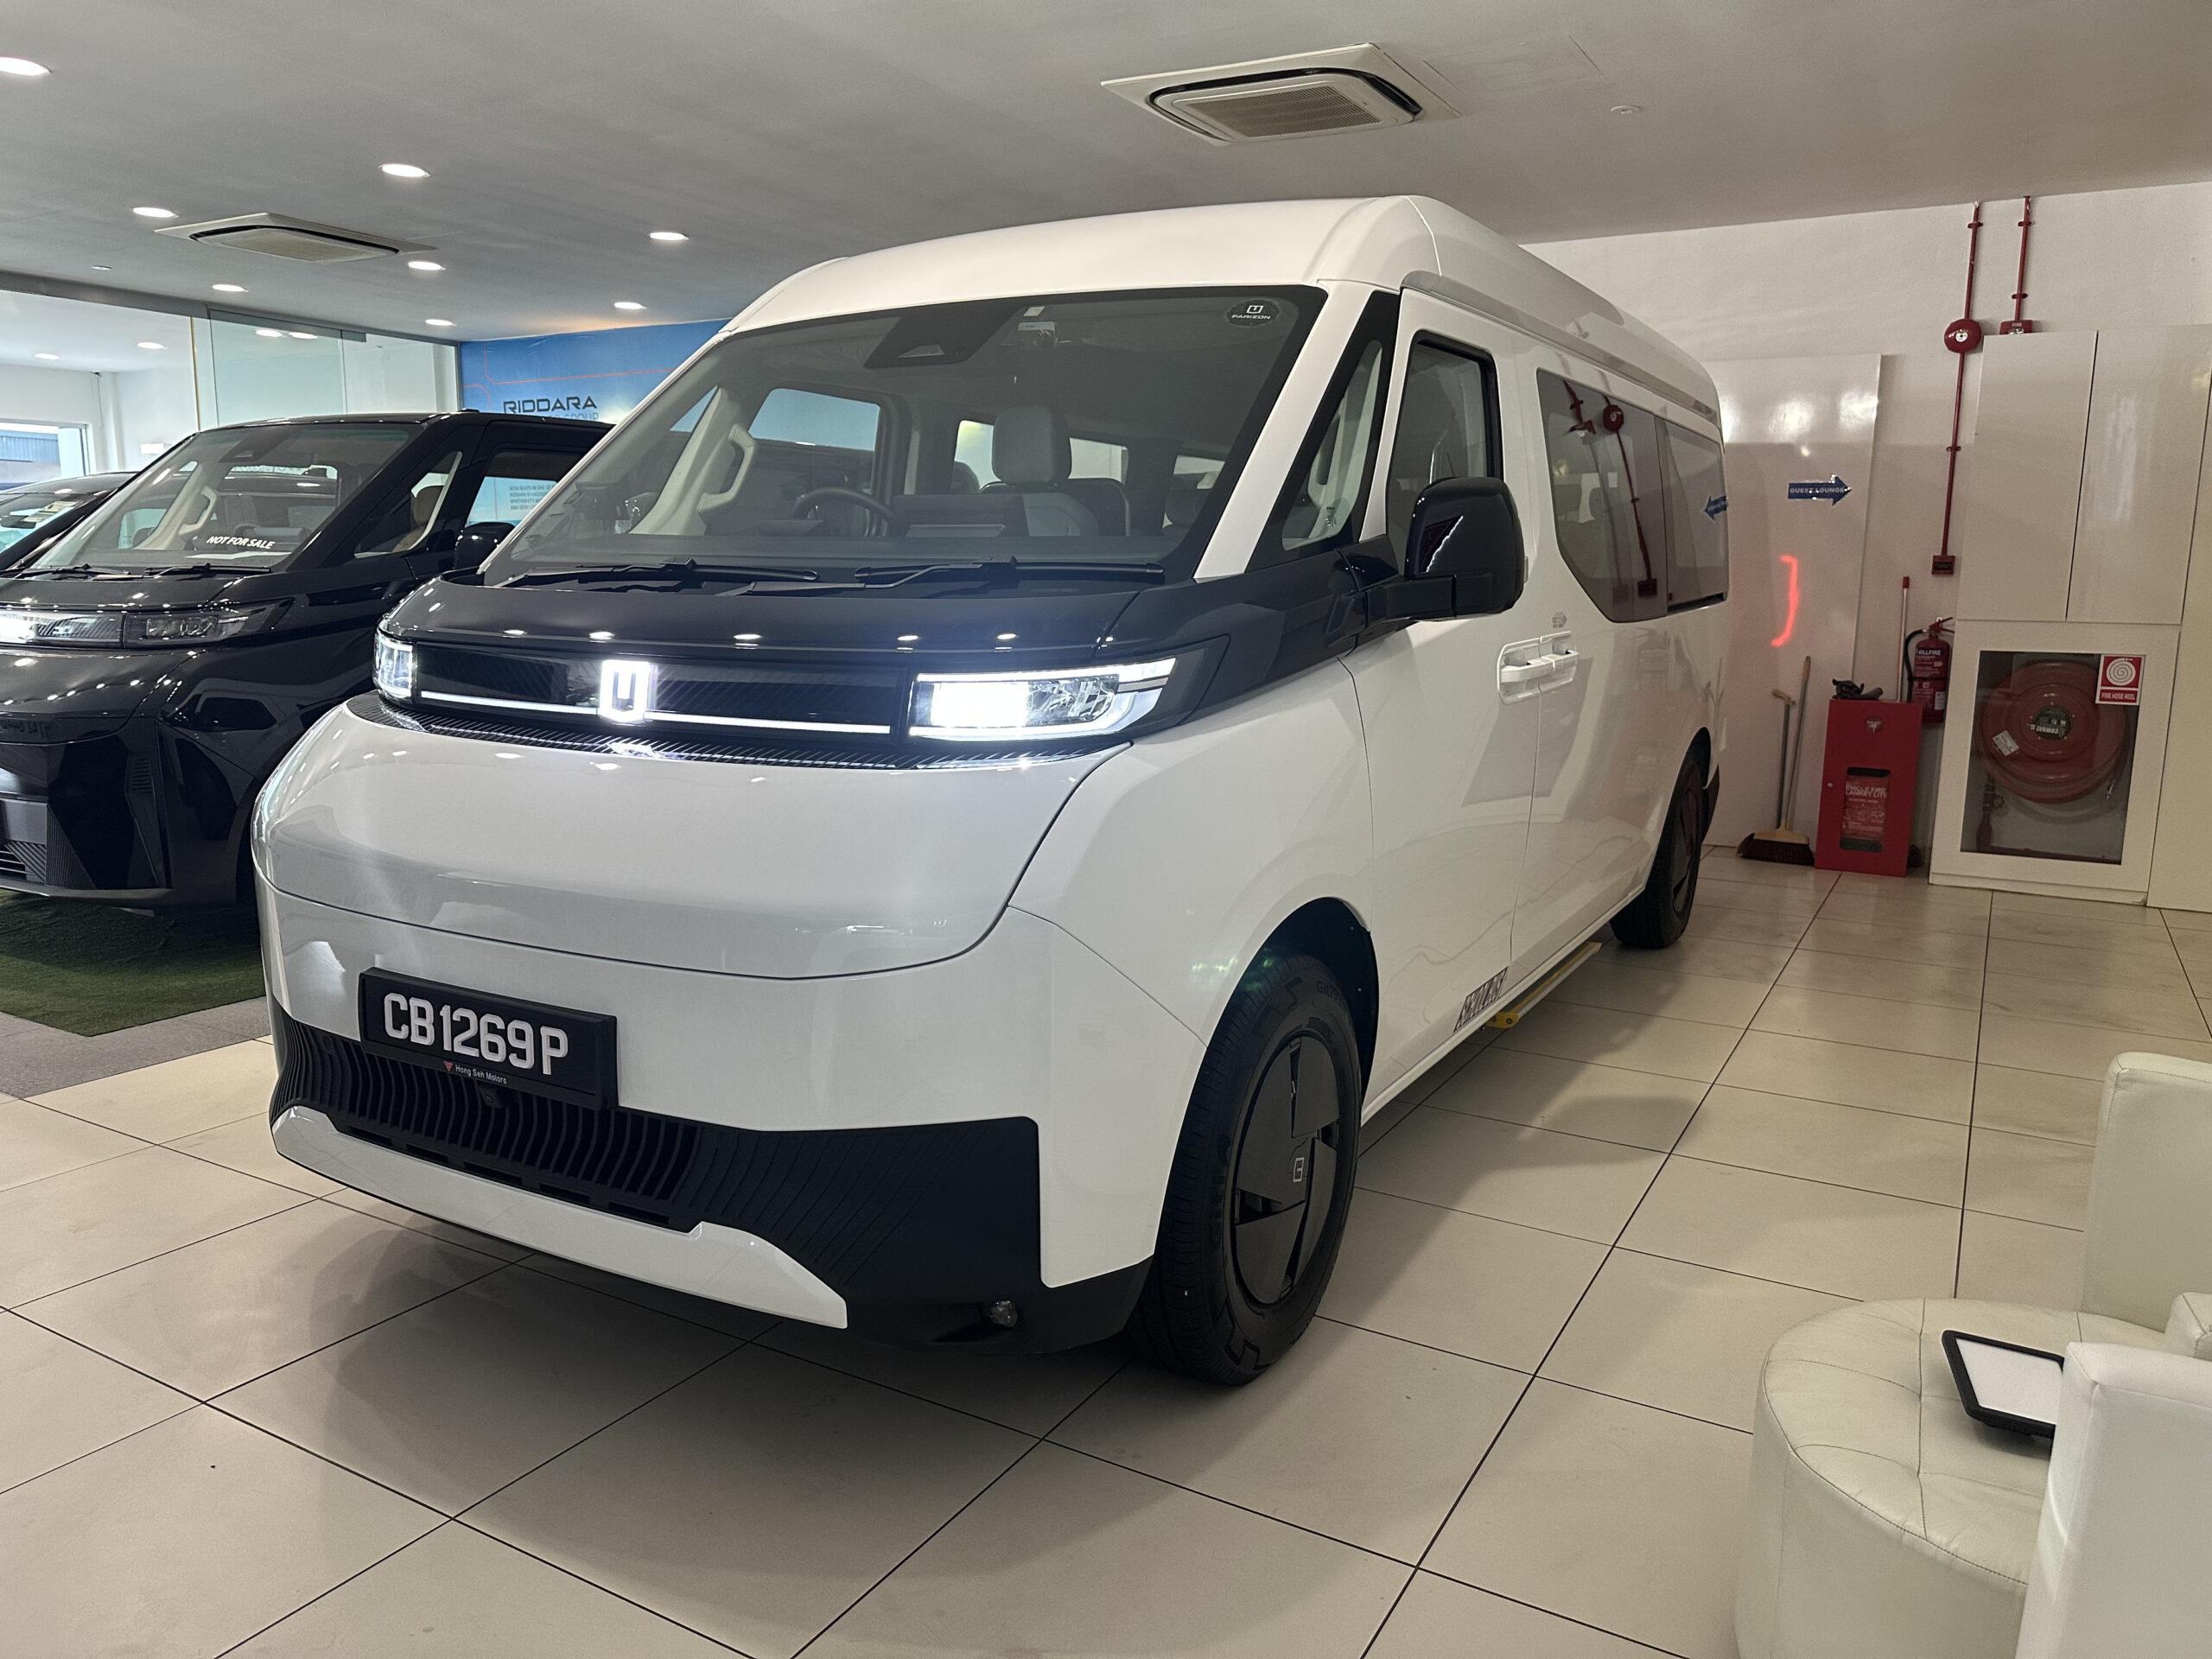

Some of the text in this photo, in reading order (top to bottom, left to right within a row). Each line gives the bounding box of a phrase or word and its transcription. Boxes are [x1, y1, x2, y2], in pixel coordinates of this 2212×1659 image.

[503, 396, 597, 414] RIDDARA
[207, 536, 276, 550] NOT FOR SALE
[384, 993, 569, 1076] CB1269P
[455, 1064, 507, 1084] Hong Seh Motors
